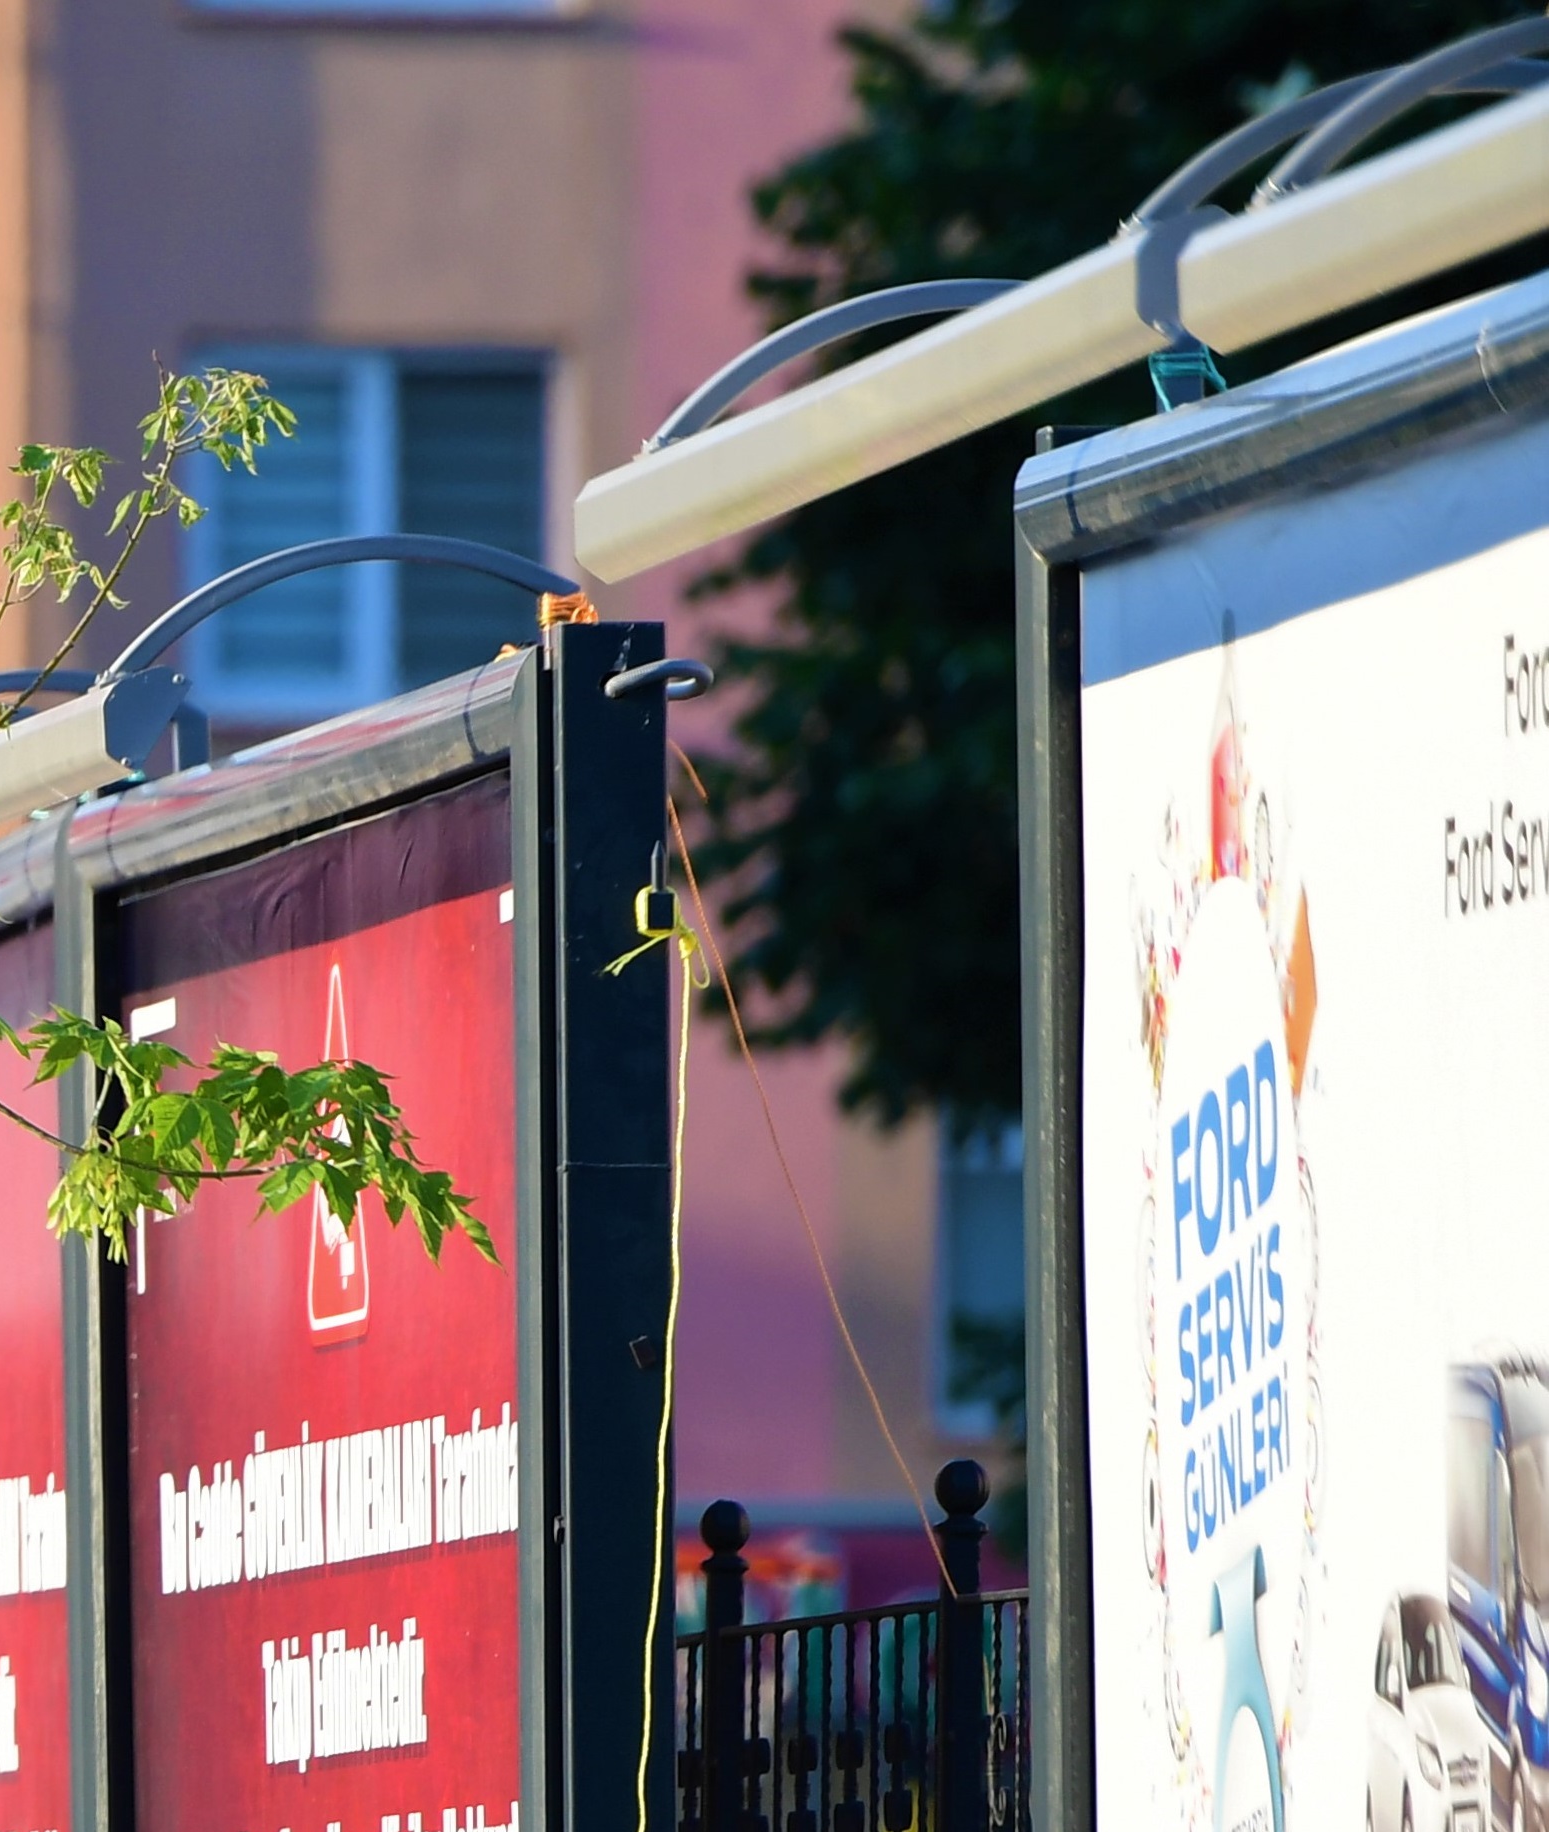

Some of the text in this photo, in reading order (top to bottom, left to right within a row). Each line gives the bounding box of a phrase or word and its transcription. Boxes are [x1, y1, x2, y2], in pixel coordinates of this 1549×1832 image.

[1443, 799, 1493, 919] Ford
[1170, 1039, 1280, 1282] FORD
[1177, 1221, 1286, 1428] SERVİS
[187, 1459, 243, 1591] Cadde
[243, 1420, 324, 1582] GÜVENLİK
[1182, 1361, 1292, 1554] GÜNLERİ
[262, 1641, 313, 1773] Takip
